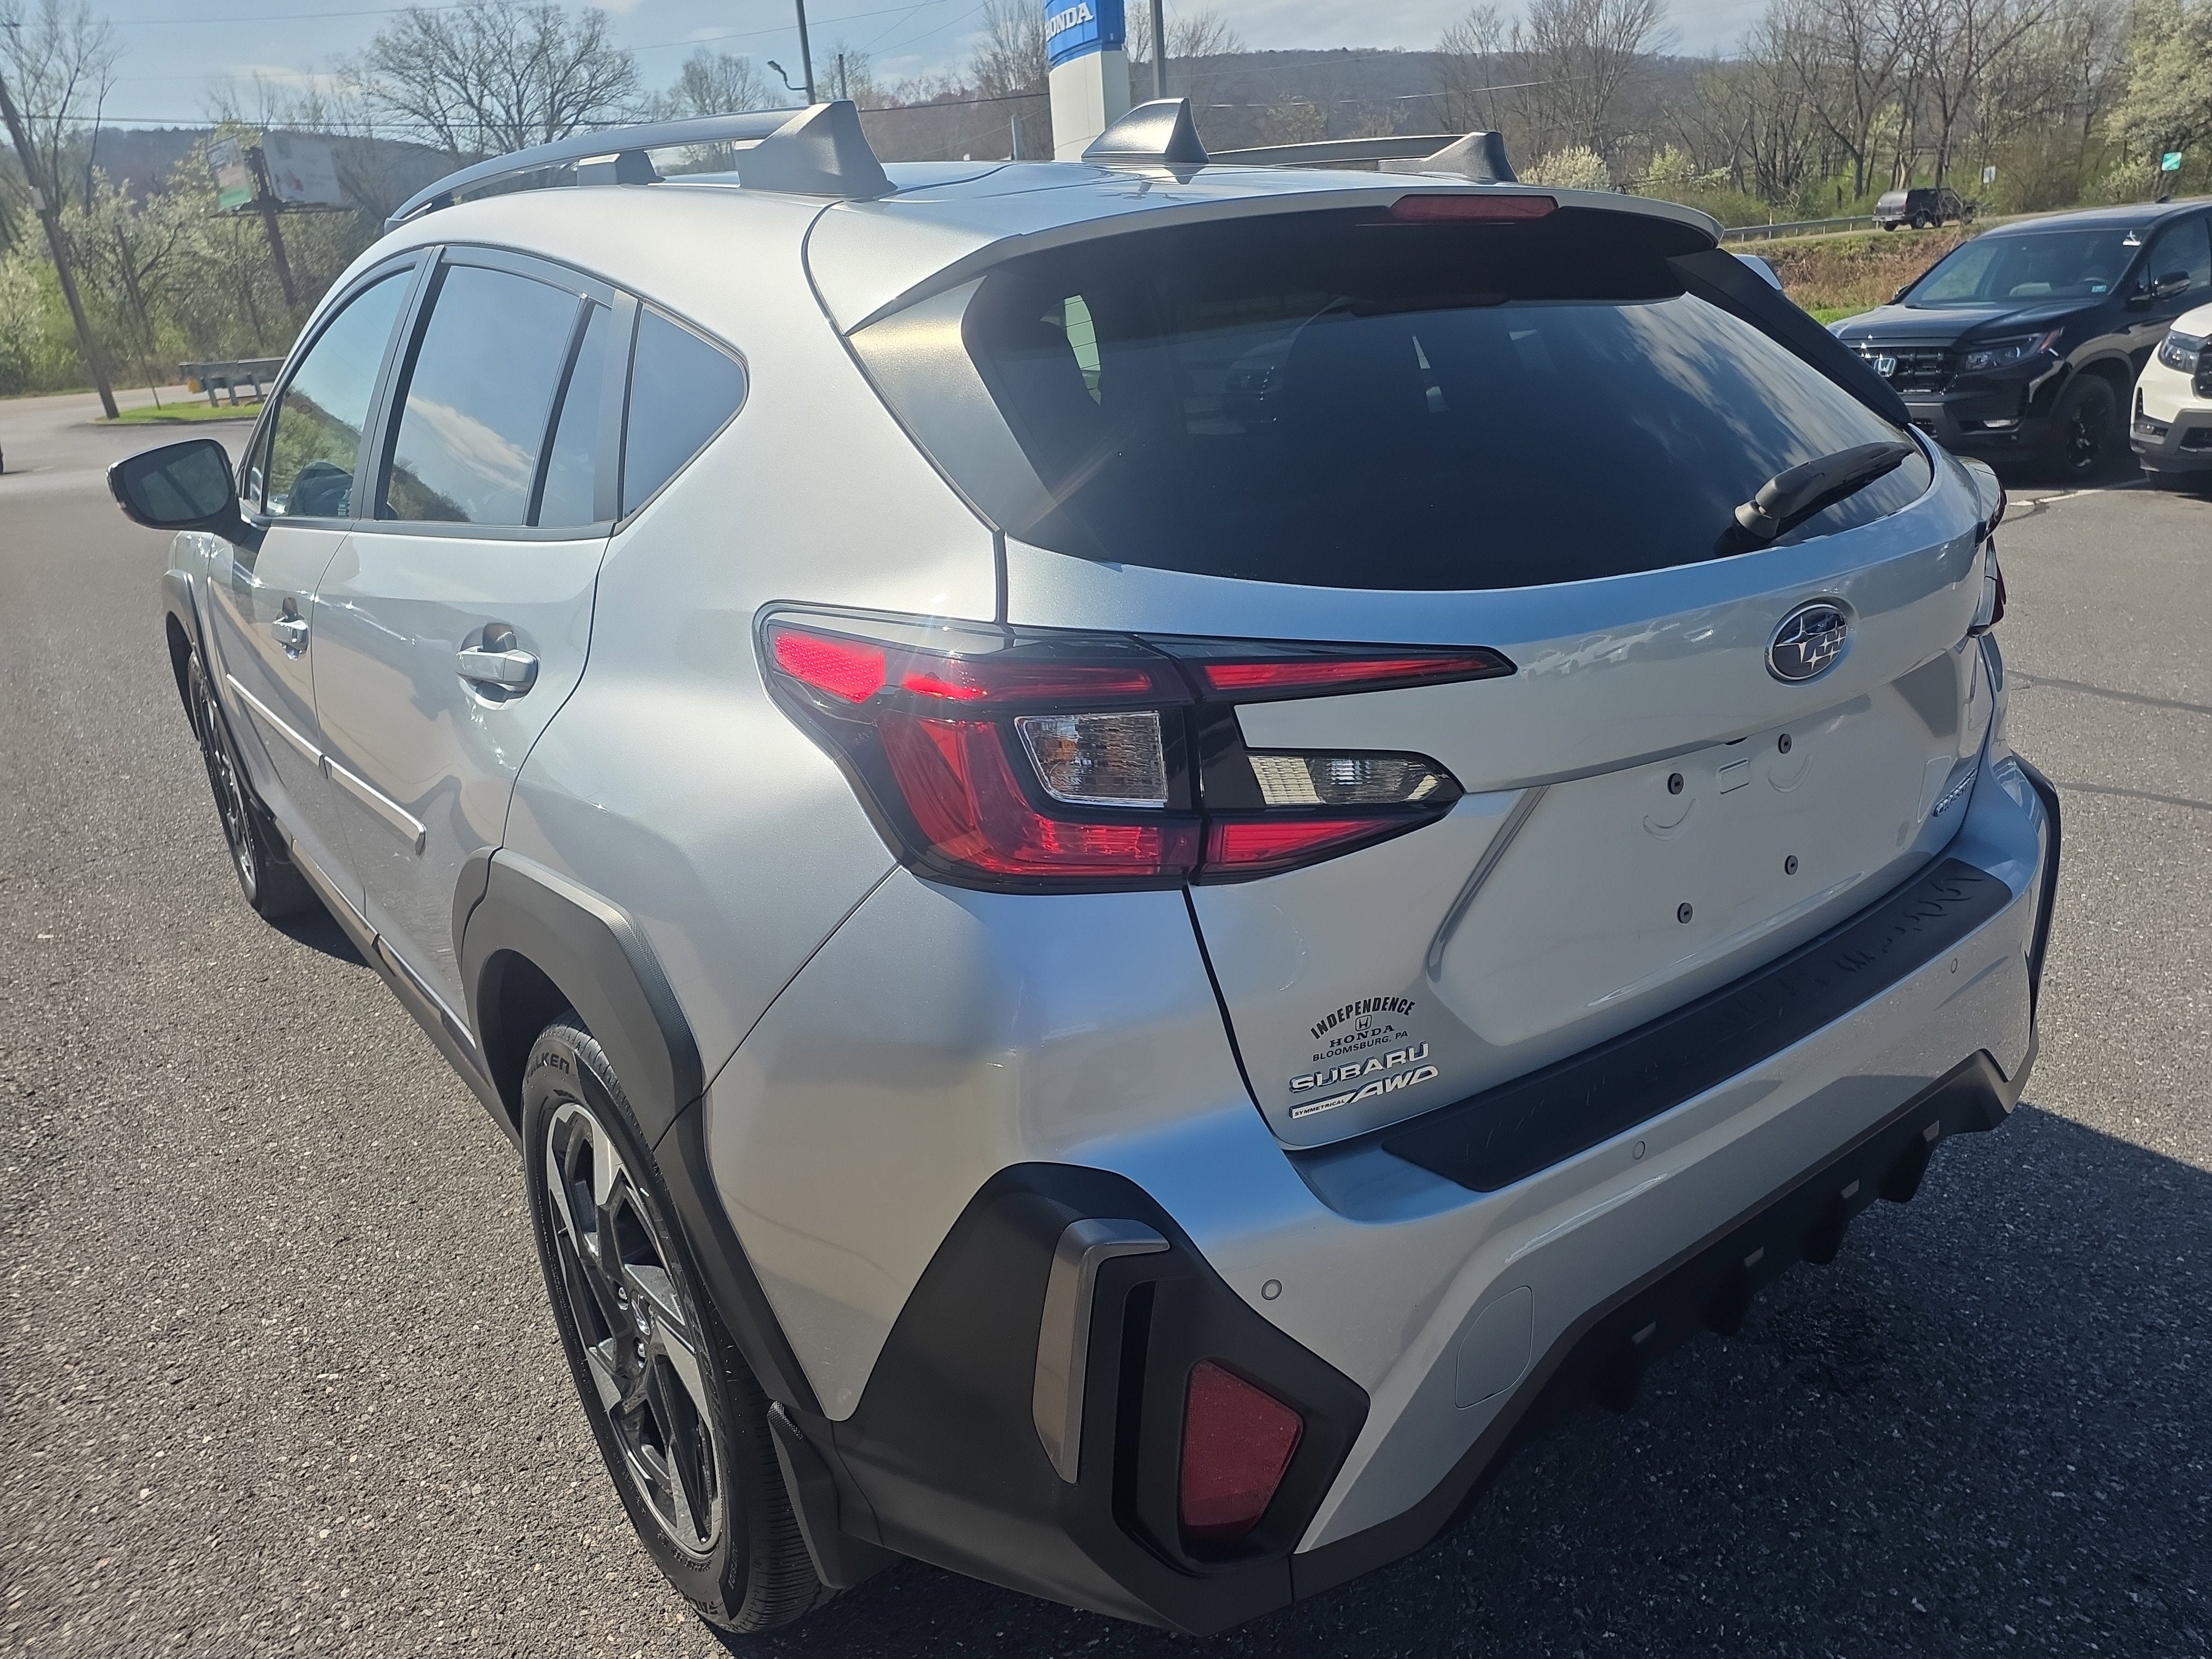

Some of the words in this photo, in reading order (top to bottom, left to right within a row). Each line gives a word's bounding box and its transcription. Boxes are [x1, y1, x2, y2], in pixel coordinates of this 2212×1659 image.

[1310, 996, 1416, 1039] INDEPENDENCE
[1329, 1025, 1395, 1048] HONDA
[1289, 1041, 1429, 1093] SUBARU
[1313, 1036, 1392, 1062] BLOOMSBURG,
[1395, 1030, 1409, 1040] PA
[1294, 1098, 1346, 1116] SYMMETRICAL
[1348, 1064, 1439, 1103] AWD
